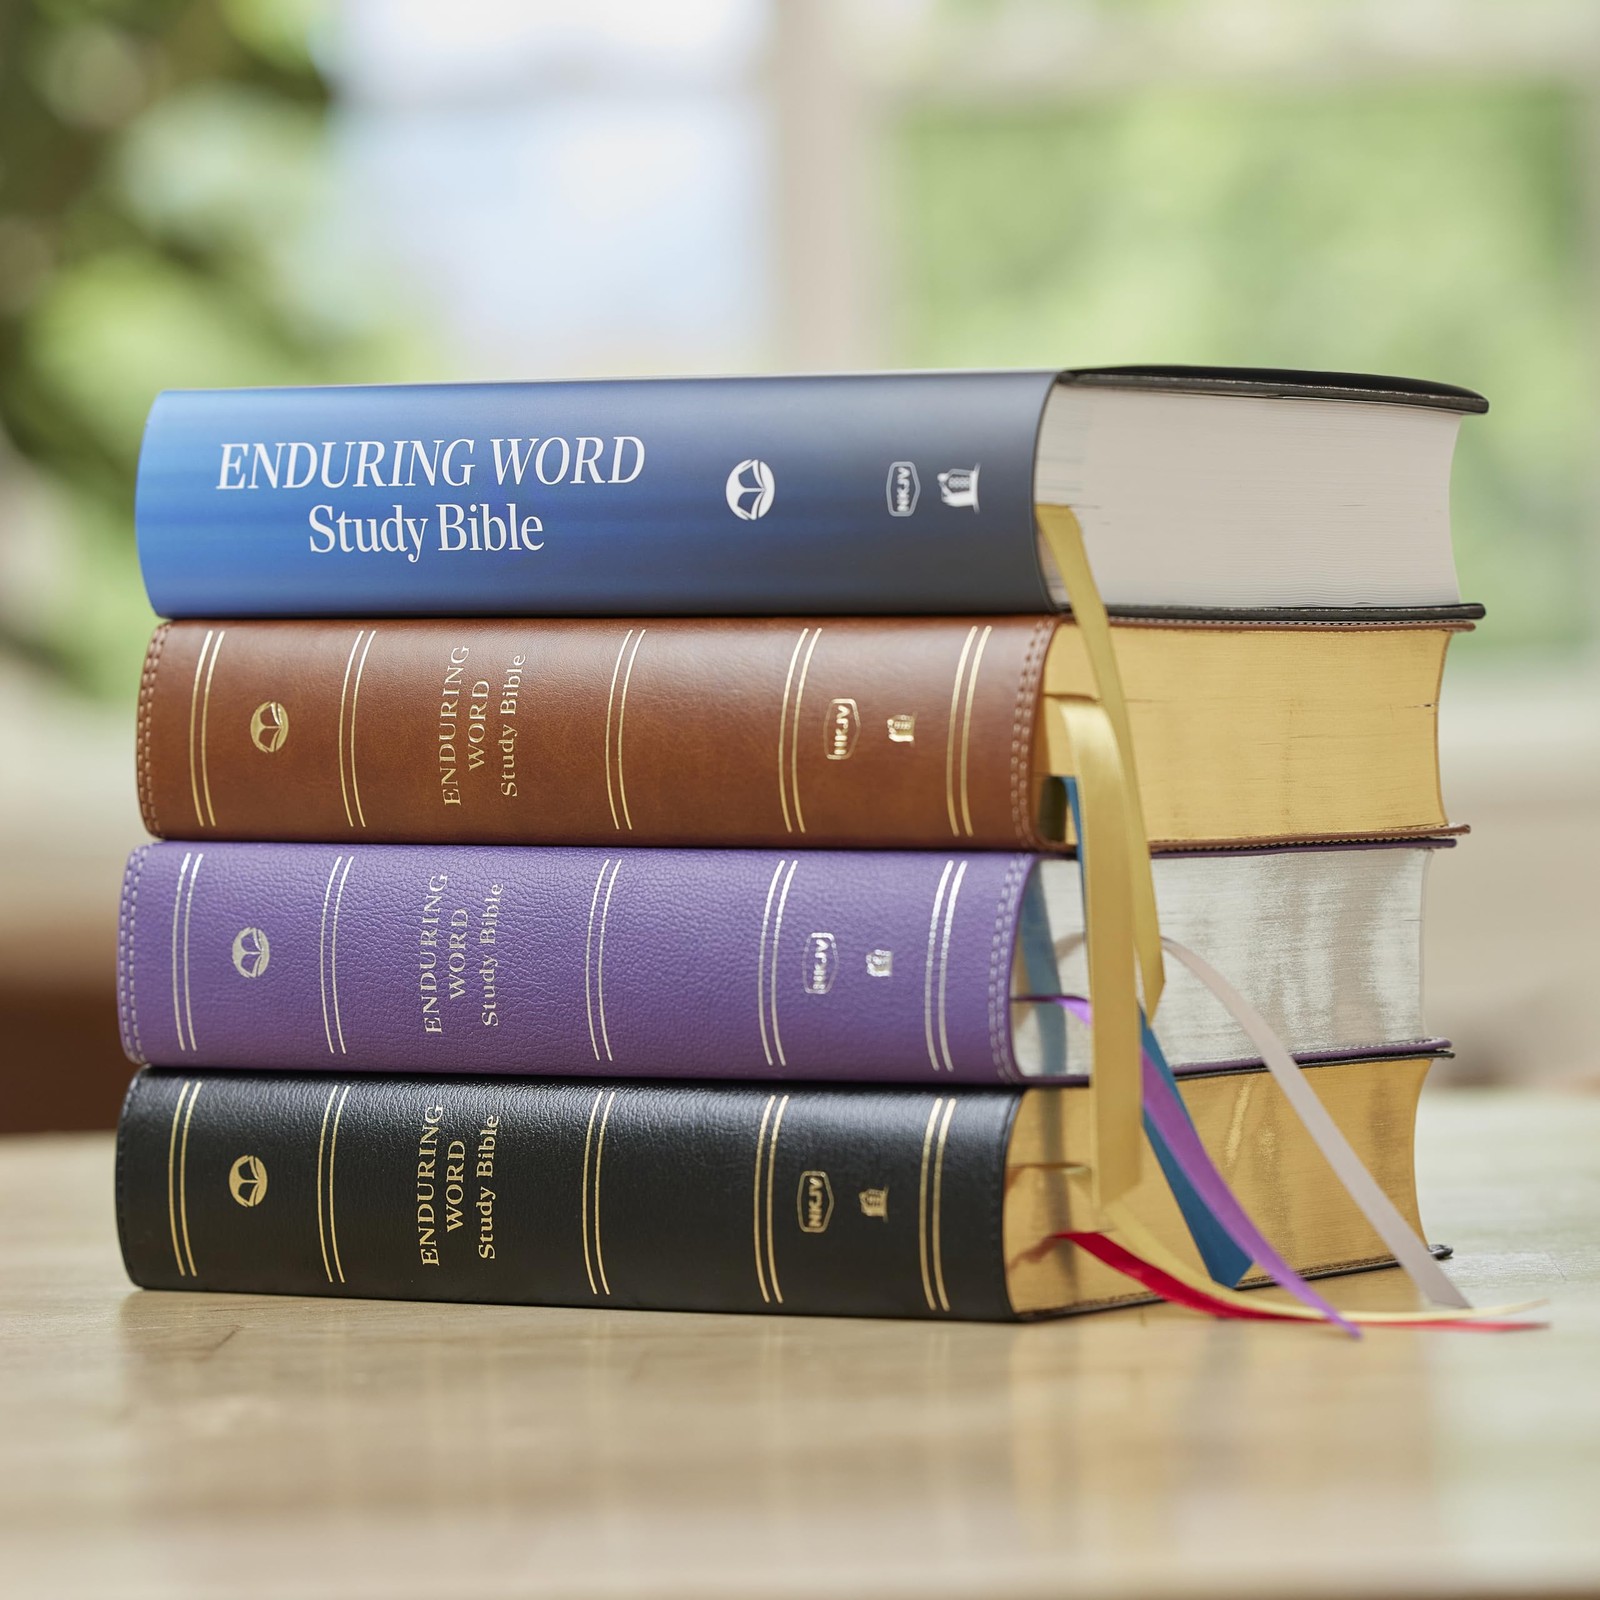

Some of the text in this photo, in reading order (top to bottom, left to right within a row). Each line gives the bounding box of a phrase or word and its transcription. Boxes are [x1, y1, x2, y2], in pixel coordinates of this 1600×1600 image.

[216, 436, 646, 490] ENDURING WORD
[308, 503, 545, 563] Study Bible
[438, 645, 470, 806] ENDURING
[467, 680, 490, 772] WORD
[498, 653, 526, 797] Study Bible
[419, 873, 448, 1034] ENDURING
[449, 908, 468, 1000] WORD
[479, 883, 504, 1027] Study Bible
[416, 1104, 443, 1266] ENDURING
[445, 1140, 466, 1232] WORD
[475, 1114, 499, 1259] Study Bible
